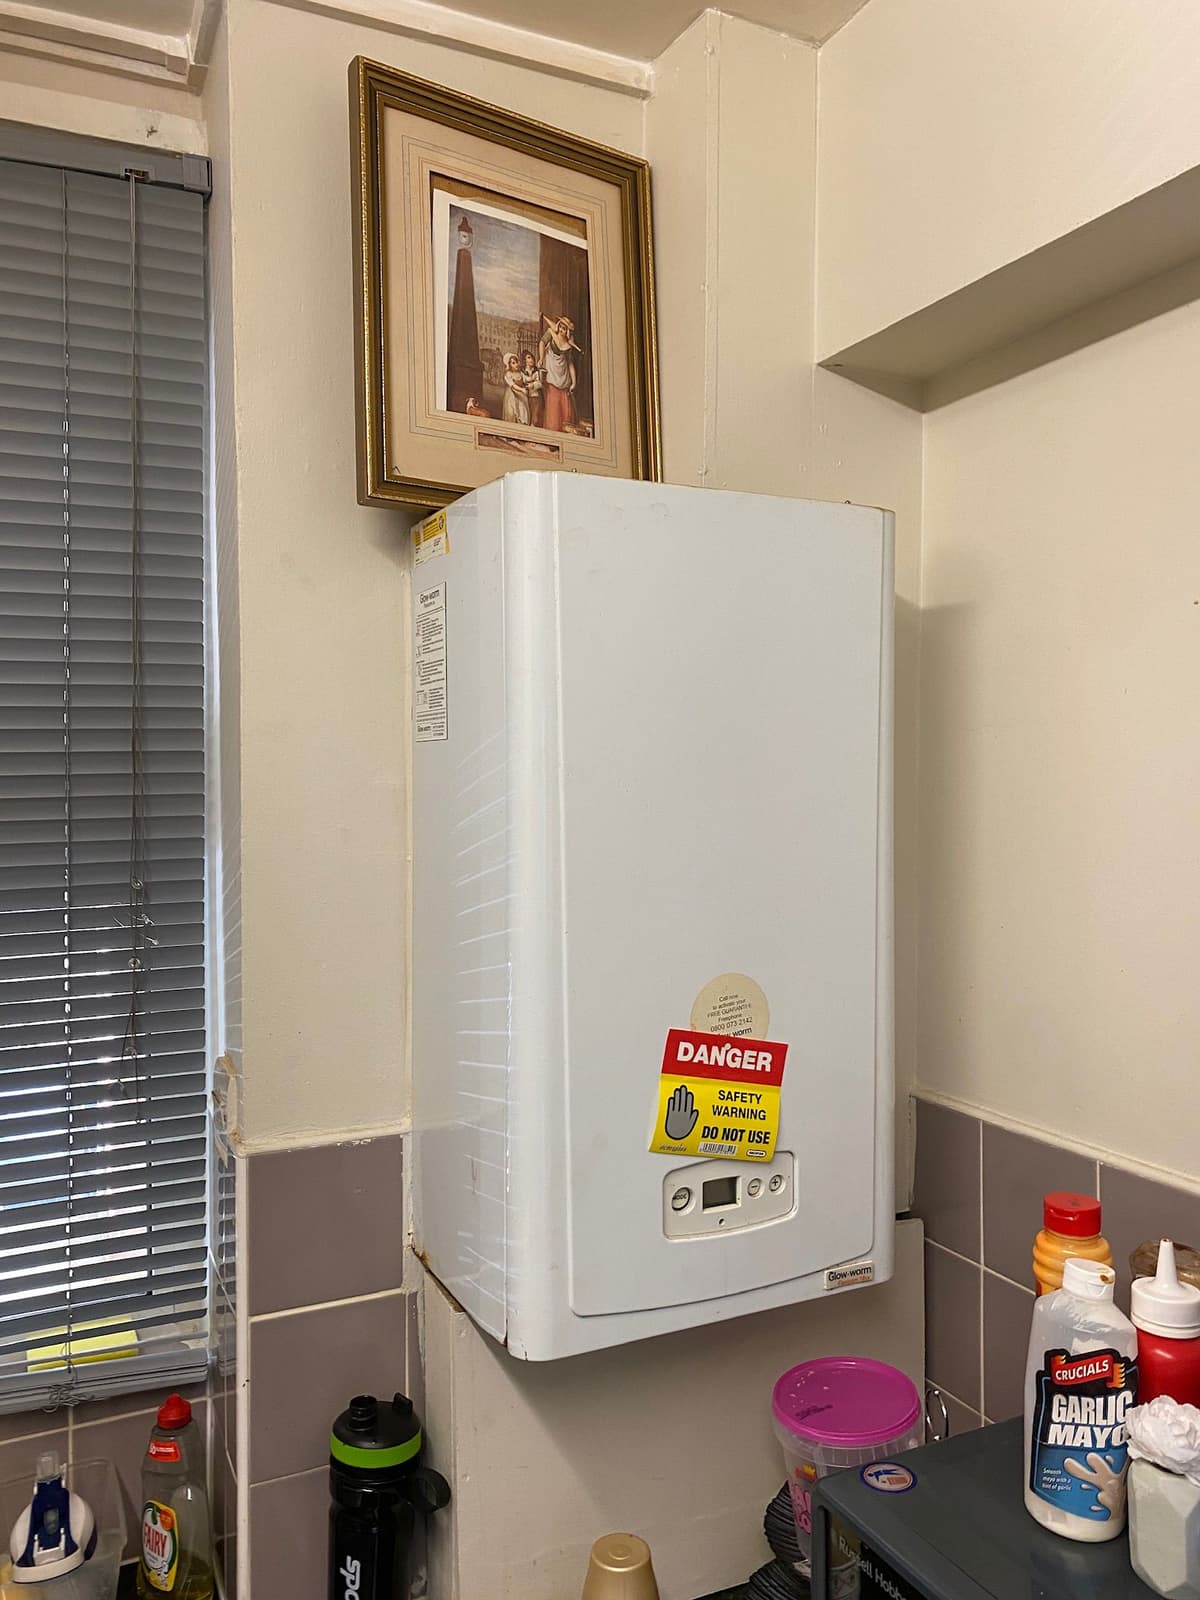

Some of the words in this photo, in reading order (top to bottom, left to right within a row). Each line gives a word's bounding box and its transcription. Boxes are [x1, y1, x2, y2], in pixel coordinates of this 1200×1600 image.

[707, 1010, 721, 1018] FREE
[726, 1020, 738, 1029] 073
[677, 1042, 773, 1072] DANGER
[718, 1090, 762, 1104] SAFETY
[712, 1105, 766, 1120] WARNING
[702, 1126, 719, 1139] DO
[721, 1127, 745, 1142] NOT
[748, 1130, 771, 1144] USE
[1055, 1359, 1109, 1381] CRUCIALS
[1052, 1390, 1134, 1425] GARLIC
[1047, 1423, 1129, 1448] MAYO
[143, 1523, 168, 1558] FAIRY
